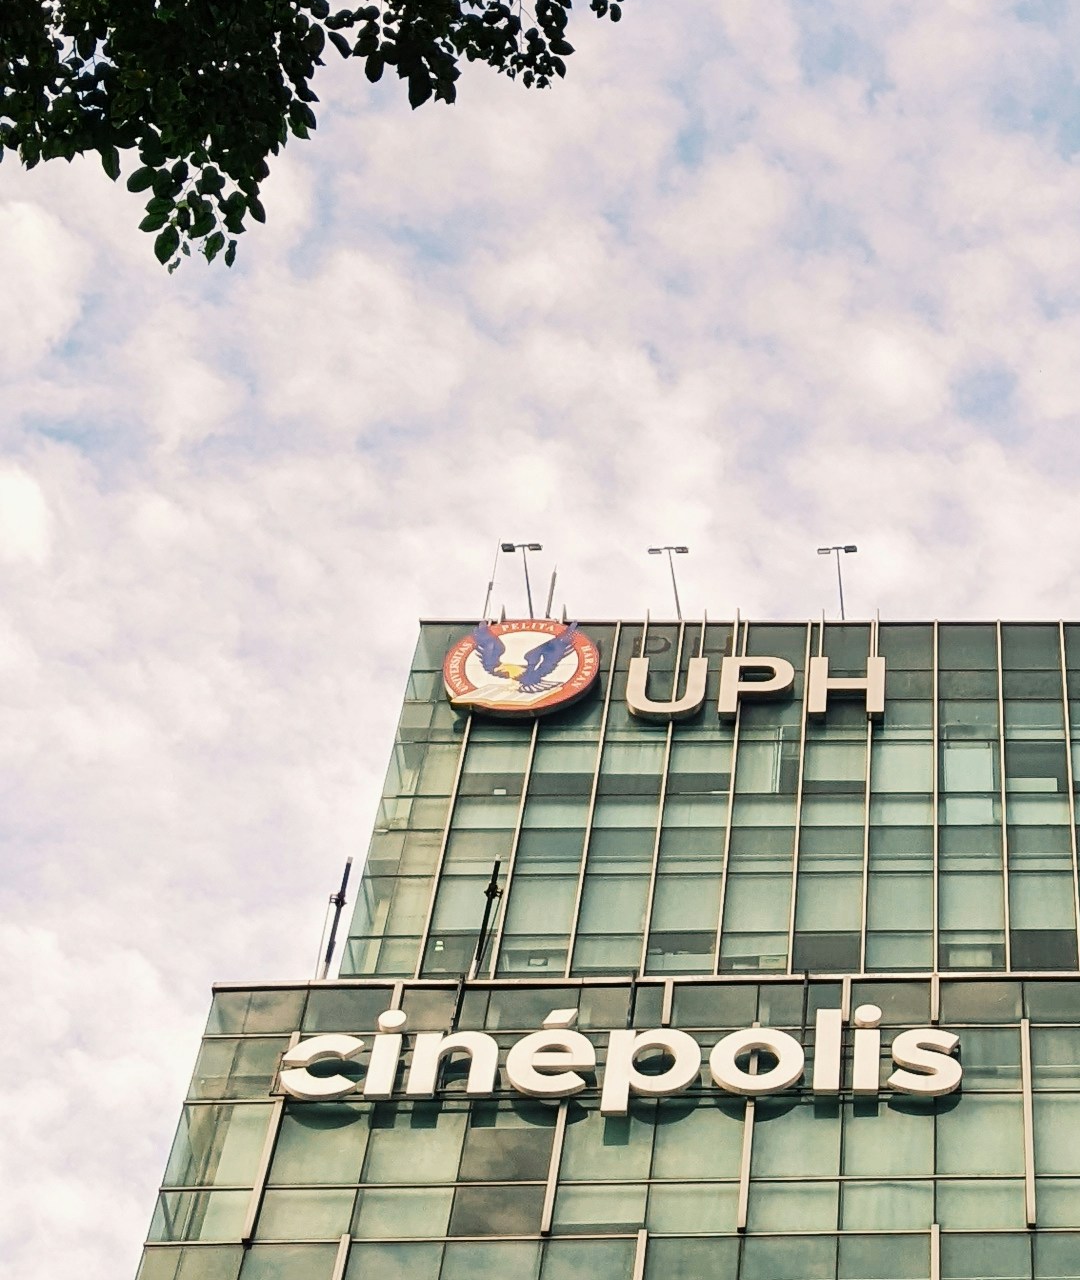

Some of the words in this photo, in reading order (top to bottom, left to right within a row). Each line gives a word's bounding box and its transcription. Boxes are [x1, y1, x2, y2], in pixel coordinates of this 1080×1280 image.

[449, 641, 473, 693] UNIVERSITAS
[501, 622, 555, 632] PELITA
[570, 645, 594, 687] HARAPAN
[625, 656, 887, 720] UPH
[280, 1005, 963, 1116] cinépolis
